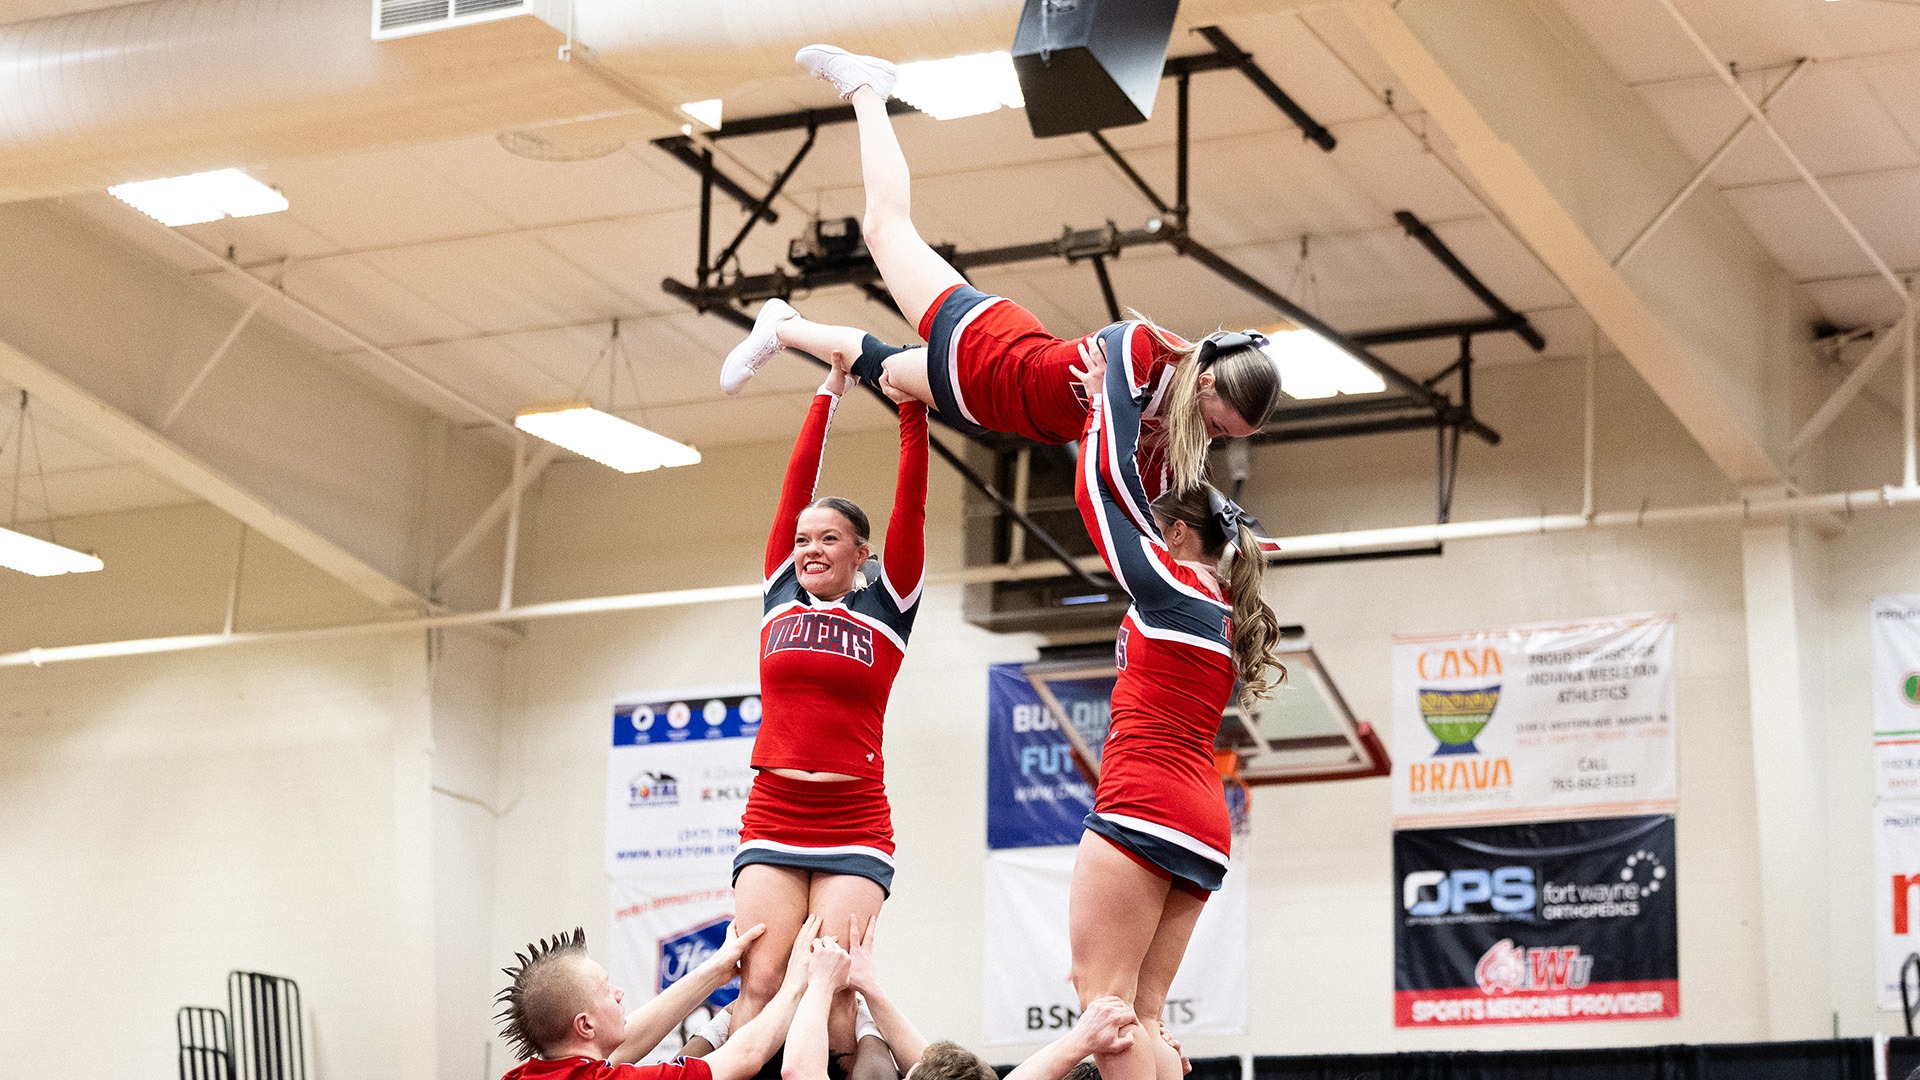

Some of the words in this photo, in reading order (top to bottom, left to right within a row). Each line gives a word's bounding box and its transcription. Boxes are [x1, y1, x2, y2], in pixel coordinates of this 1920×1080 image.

[764, 612, 874, 667] WILDCATS
[1417, 647, 1502, 681] CASA
[1528, 651, 1572, 665] PROUD
[1526, 670, 1584, 687] INDIANA
[1587, 663, 1659, 683] WESLEYAN
[1557, 685, 1630, 703] ATHLETICS
[1013, 700, 1112, 733] BUDIN
[1409, 758, 1513, 793] BRAVA
[1403, 866, 1536, 915] OPS
[1543, 882, 1577, 903] fort
[1577, 882, 1640, 905] wayne
[1542, 901, 1640, 920] ORTHOPEDICS
[1412, 997, 1485, 1021] SPORTS
[1486, 995, 1571, 1019] MEDICINE
[1571, 991, 1664, 1017] PROVIDER
